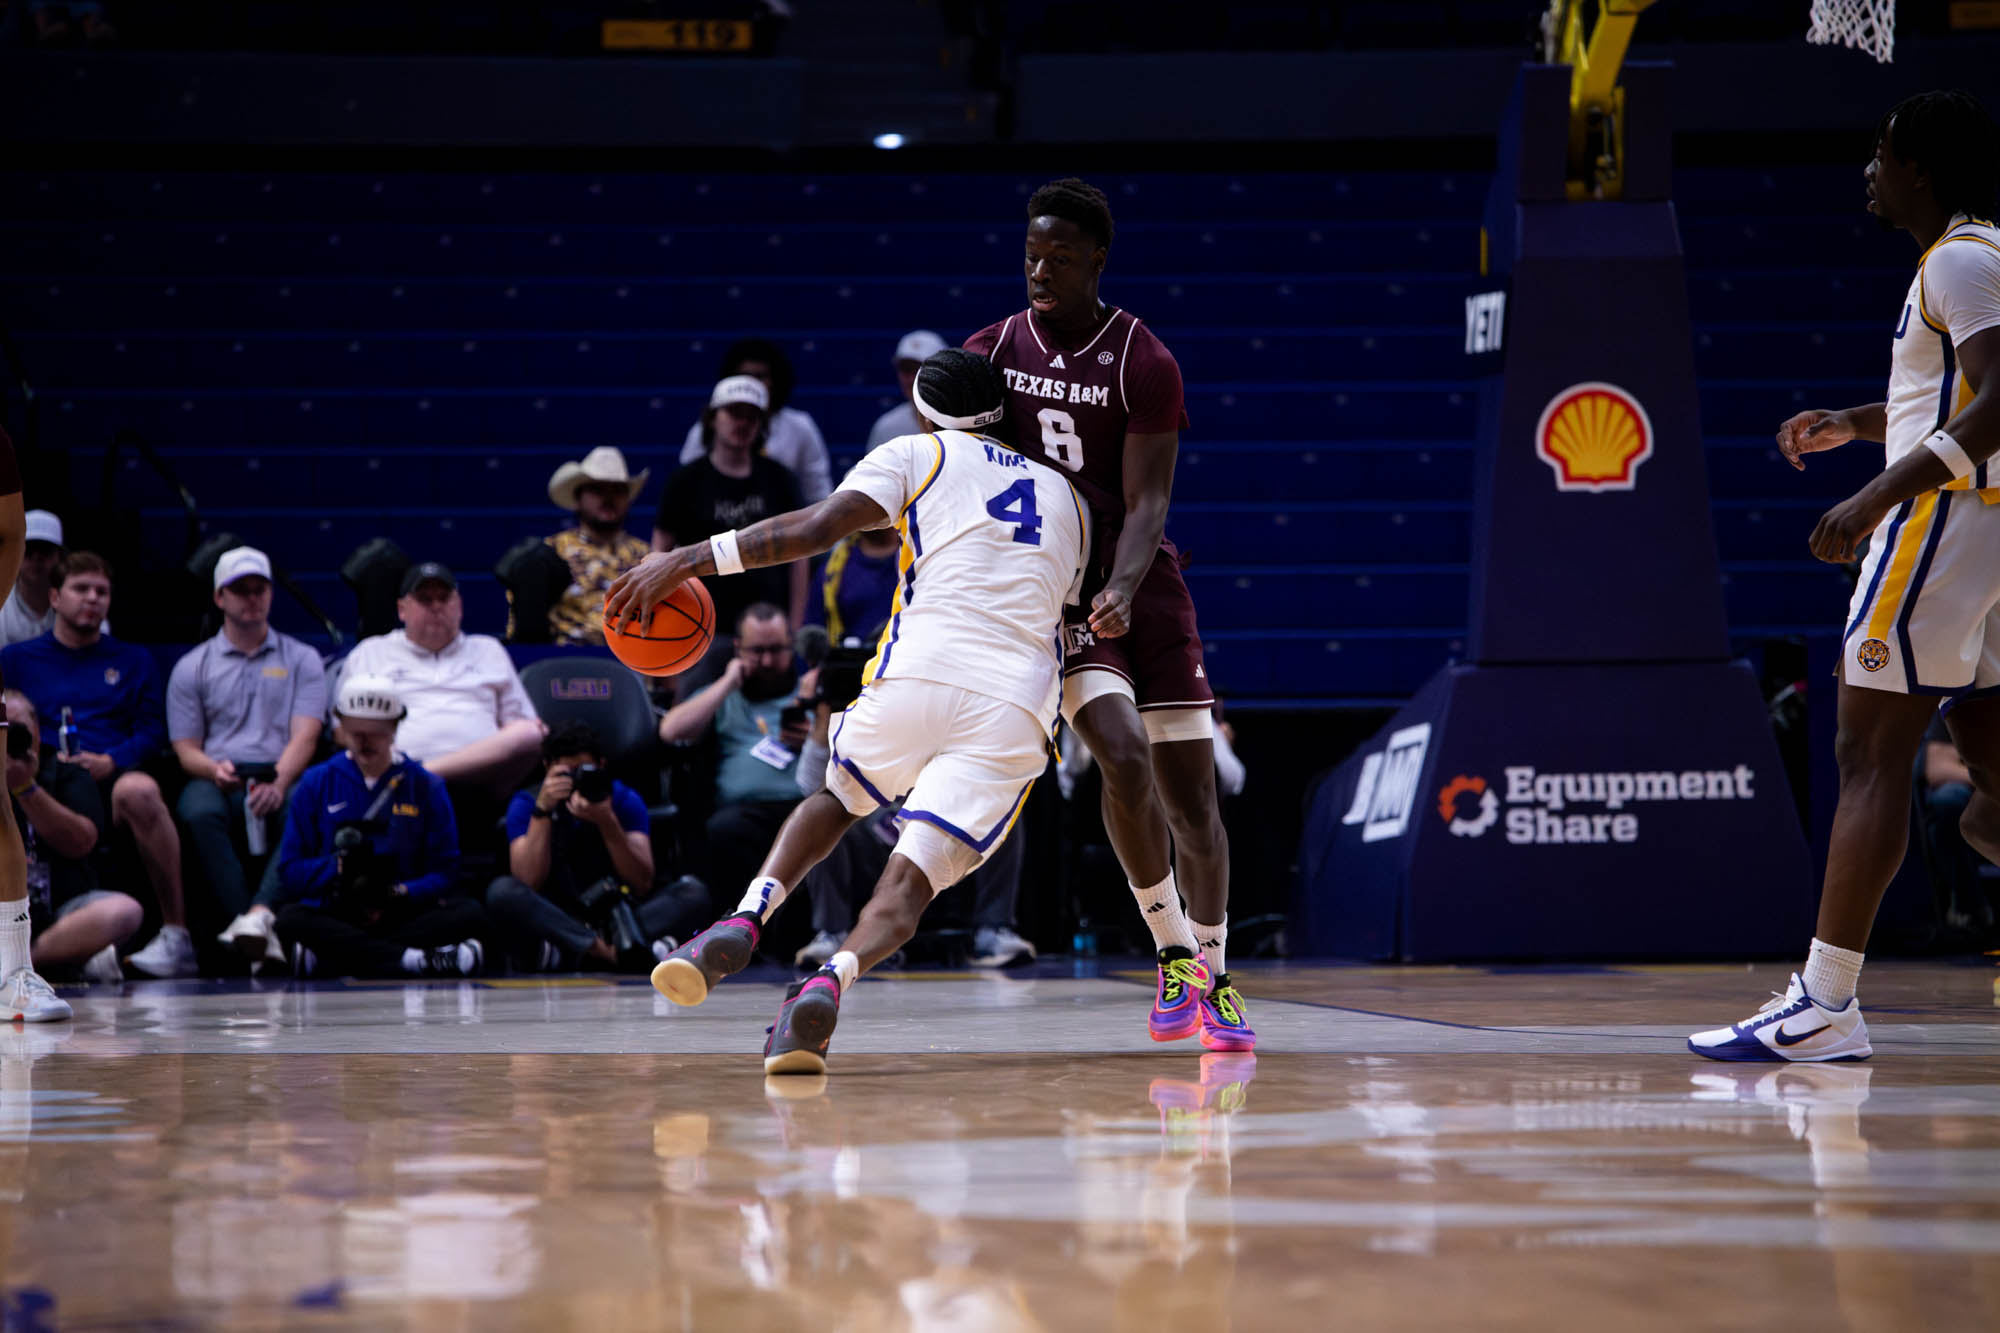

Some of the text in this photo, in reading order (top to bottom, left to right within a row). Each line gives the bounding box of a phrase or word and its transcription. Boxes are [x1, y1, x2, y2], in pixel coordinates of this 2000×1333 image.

[1099, 353, 1113, 364] SEC
[1003, 367, 1110, 407] TEXAS A&M
[983, 444, 1029, 471] KING
[1037, 407, 1085, 473] 6
[986, 479, 1042, 546] 4
[551, 677, 612, 701] LSU
[1504, 763, 1755, 810] Equipment
[1505, 806, 1639, 845] Share
